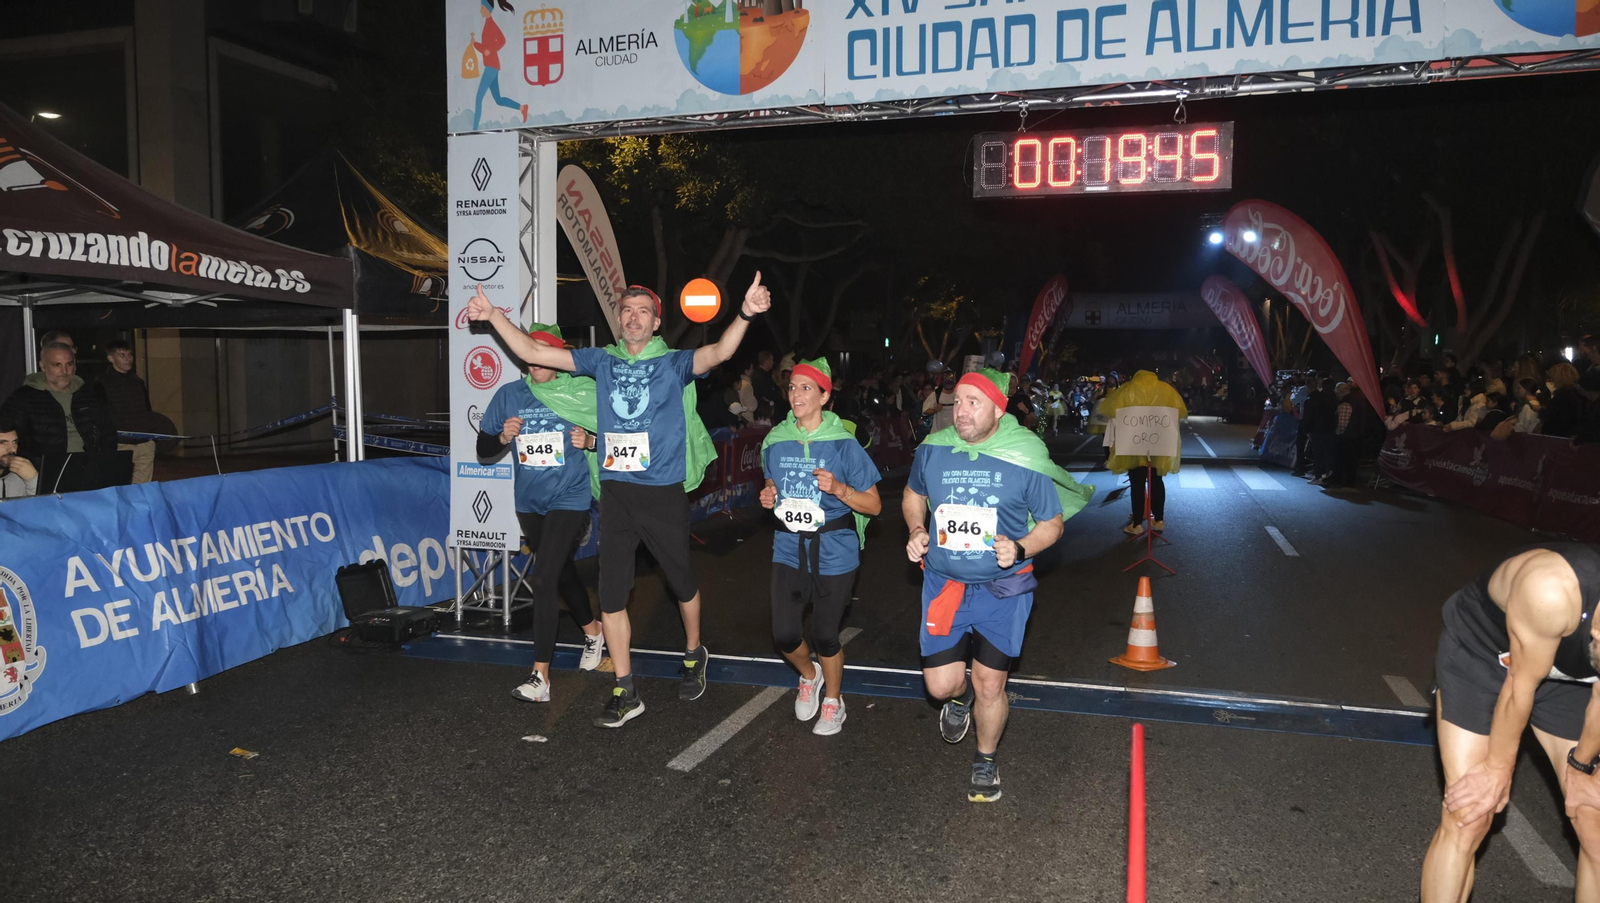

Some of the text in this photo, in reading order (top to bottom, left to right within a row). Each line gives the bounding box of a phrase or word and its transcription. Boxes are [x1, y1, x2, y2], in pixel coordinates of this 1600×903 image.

[575, 29, 659, 56] ALMERÍA
[847, 13, 1036, 81] CIUDAD
[1056, 4, 1127, 64] DE
[594, 52, 639, 68] CIUDAD
[456, 198, 508, 209] RENAULT
[457, 255, 506, 264] NISSAN
[1122, 414, 1171, 428] COMPRO
[1132, 432, 1160, 445] ORO
[526, 444, 554, 455] 848
[613, 446, 638, 458] 847
[459, 465, 496, 477] Almericar
[785, 511, 813, 524] 849
[946, 519, 982, 536] 846
[456, 529, 507, 541] RENAULT
[64, 511, 336, 598] AYUNTAMIENTO
[70, 559, 295, 649] DE ALMERÍA
[25, 617, 33, 653] LIBERTAD
